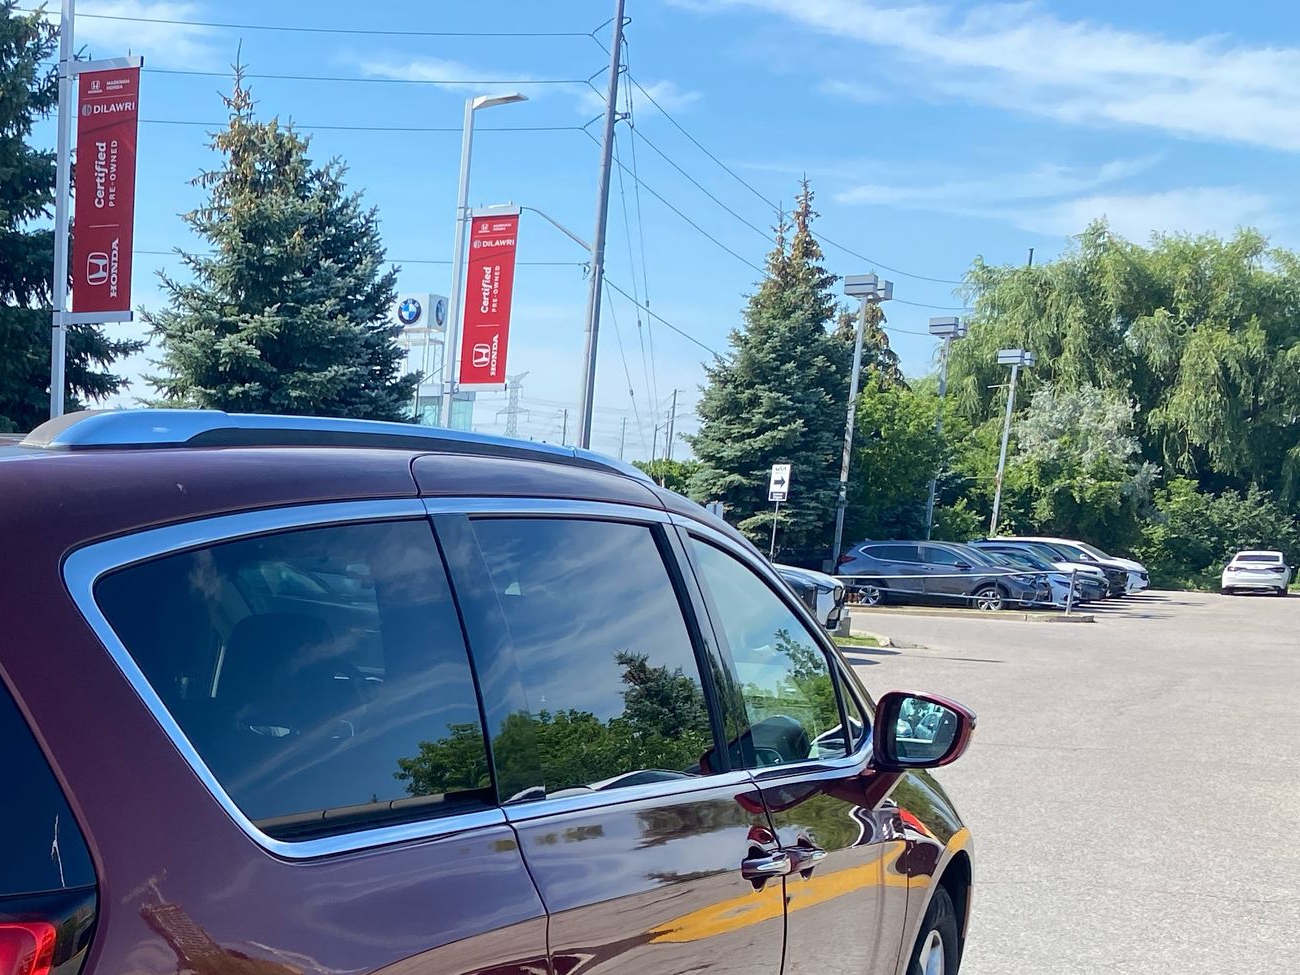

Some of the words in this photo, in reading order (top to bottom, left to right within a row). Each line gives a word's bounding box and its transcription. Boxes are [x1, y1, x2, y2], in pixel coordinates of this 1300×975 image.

[93, 102, 135, 114] DILAWRI
[94, 142, 108, 208] Certified
[109, 140, 118, 207] PRE-OWNED
[110, 237, 119, 298] HONDA
[482, 239, 515, 248] DILAWRI
[480, 266, 492, 314] Certified
[491, 265, 501, 313] PRE-OWNED
[490, 333, 499, 377] HONDA
